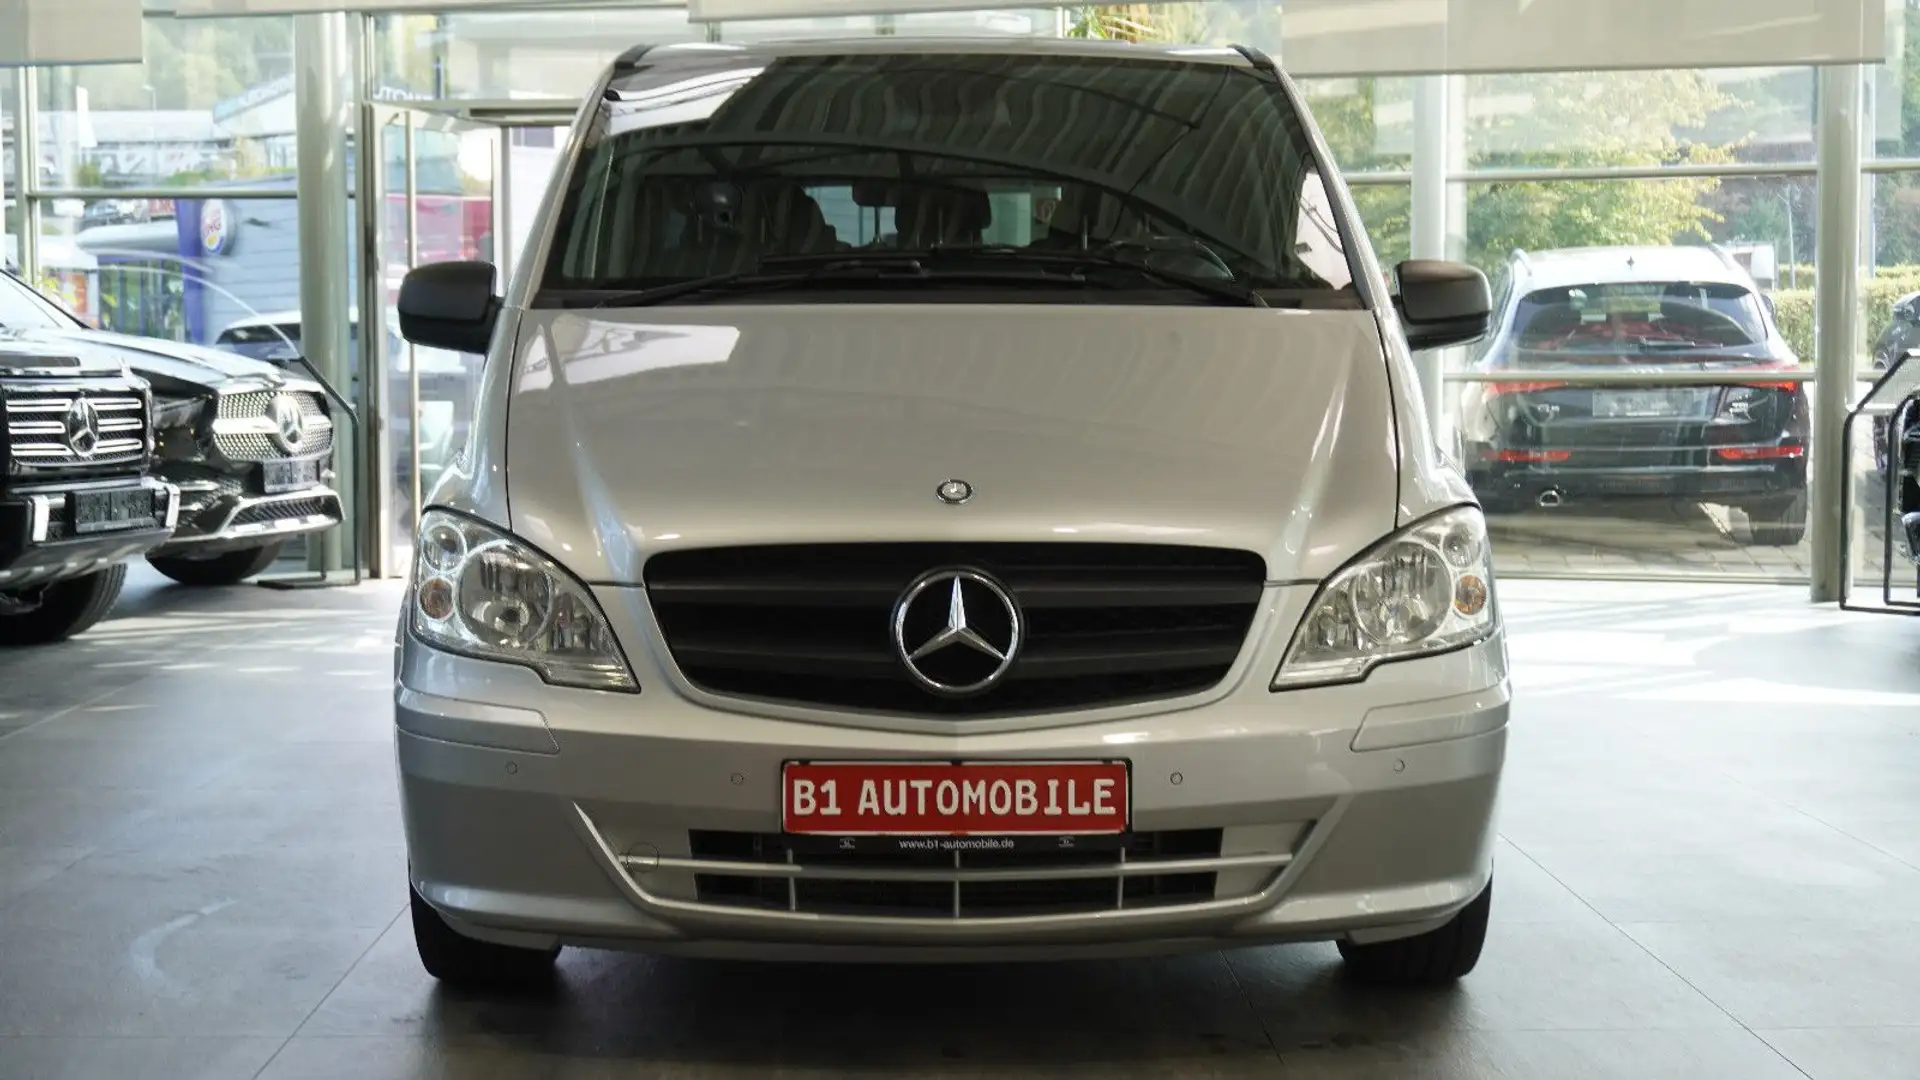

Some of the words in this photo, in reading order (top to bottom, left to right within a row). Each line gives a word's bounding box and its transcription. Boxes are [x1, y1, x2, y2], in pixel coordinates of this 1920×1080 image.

[792, 779, 842, 816] B1
[857, 779, 1117, 816] AUTOMOBILE
[899, 838, 1015, 850] www.b1-automobile.de
